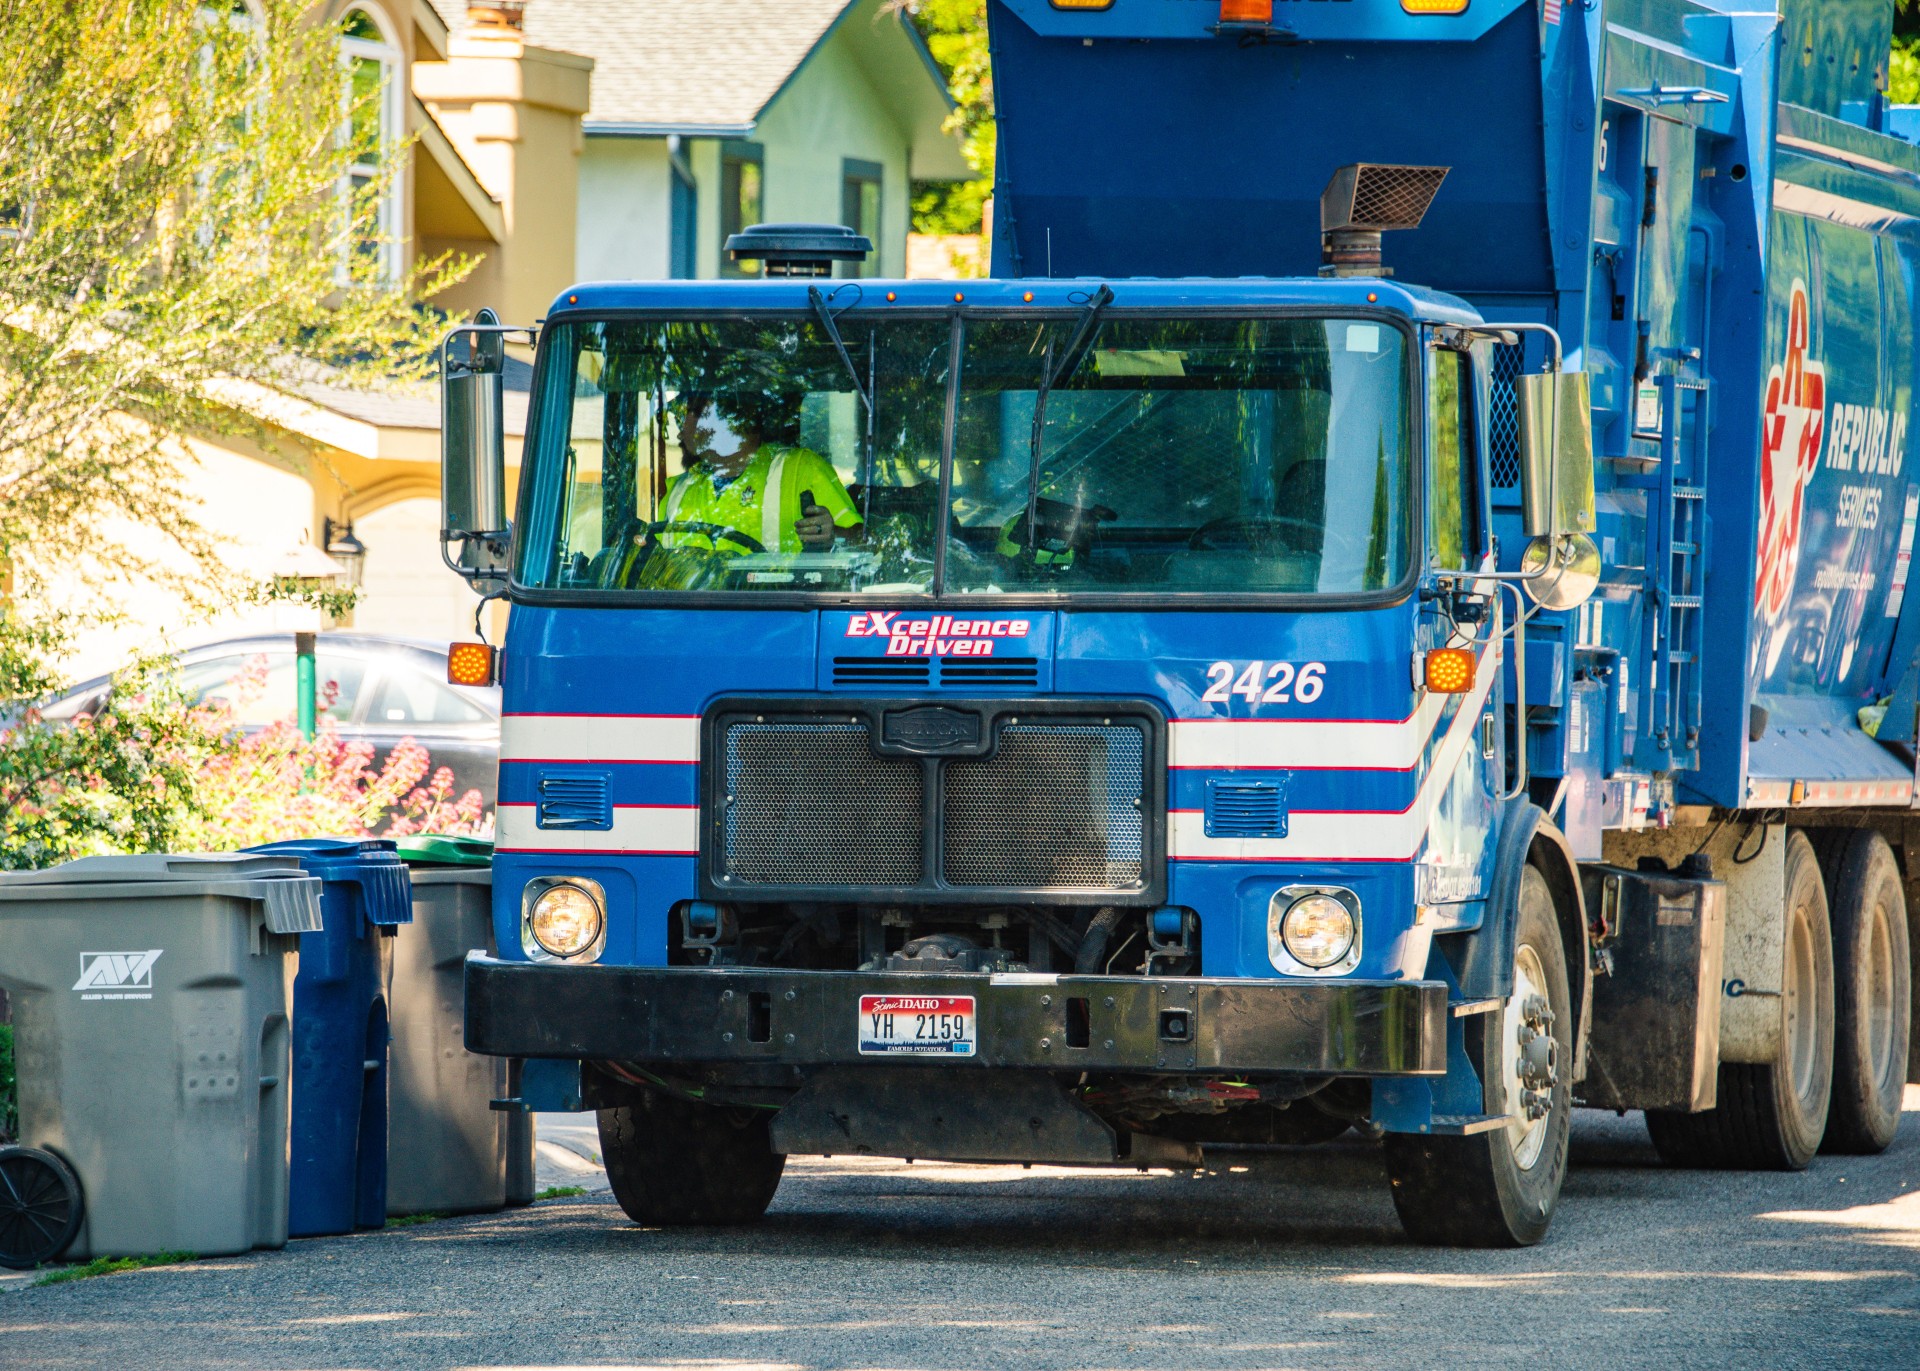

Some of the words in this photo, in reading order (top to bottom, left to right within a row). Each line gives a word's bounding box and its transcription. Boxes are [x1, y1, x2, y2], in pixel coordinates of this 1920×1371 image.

[1826, 402, 1906, 478] REPUBLIC
[1836, 484, 1882, 530] SERVICES
[845, 611, 1030, 637] EXcellence
[885, 636, 994, 656] Driven
[1201, 660, 1327, 704] 2426
[872, 1000, 900, 1012] Scenic
[899, 999, 939, 1010] IDAHO
[872, 1013, 894, 1039] YH
[915, 1013, 964, 1040] 2159
